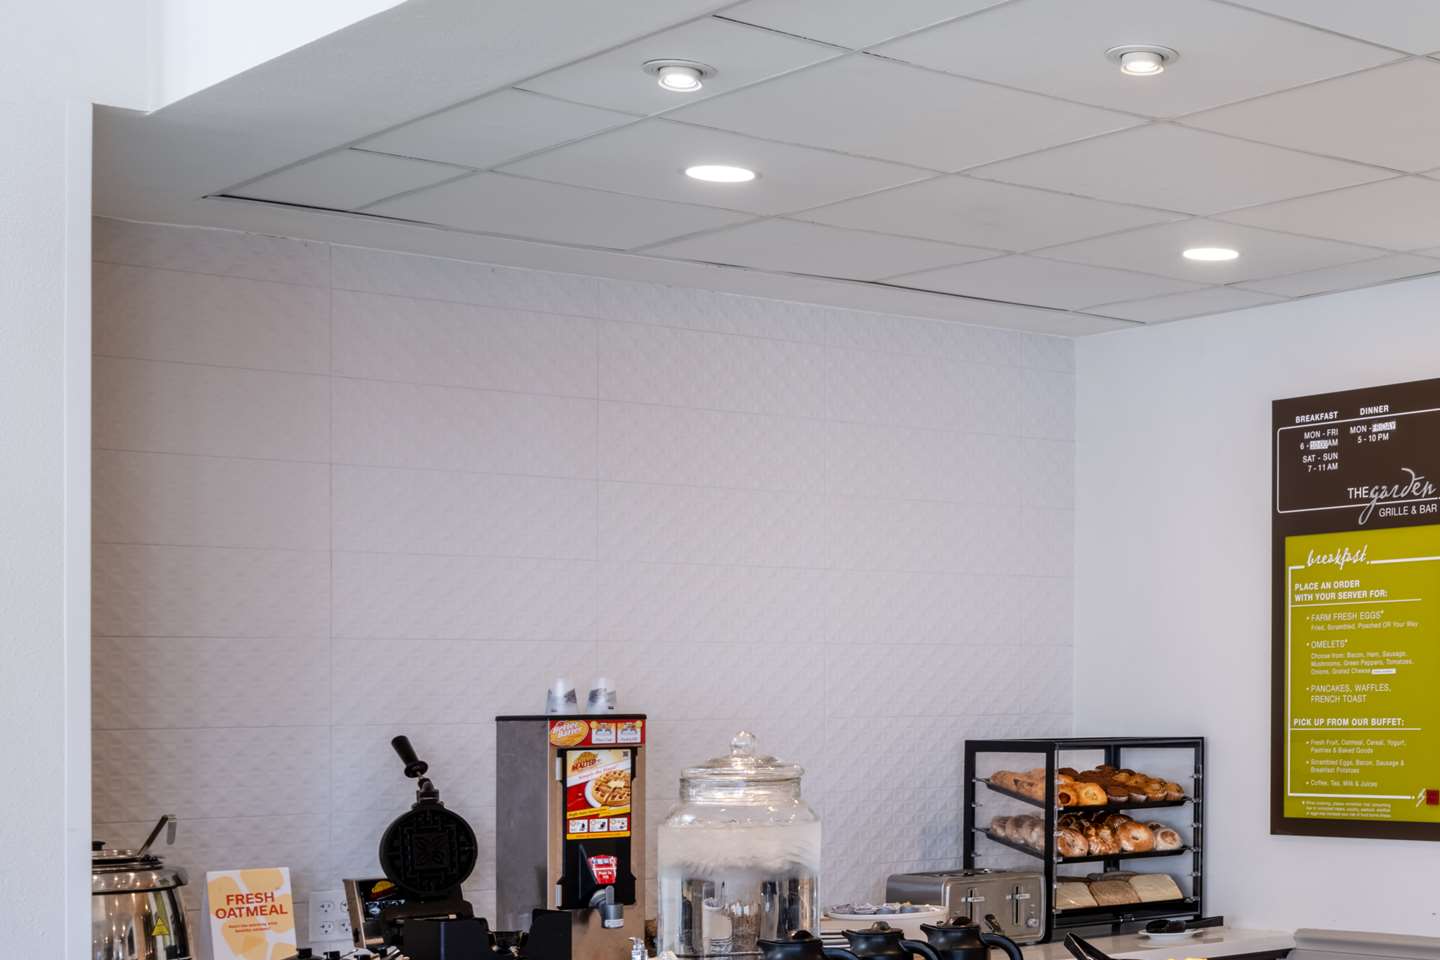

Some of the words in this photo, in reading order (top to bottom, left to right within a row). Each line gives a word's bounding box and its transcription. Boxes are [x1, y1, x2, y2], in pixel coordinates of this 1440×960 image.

[1359, 404, 1390, 416] DINNER
[1295, 411, 1338, 424] BREAKFAST
[1304, 430, 1321, 440] MON
[1326, 428, 1339, 437] FRI
[1349, 425, 1367, 434] MON
[1299, 442, 1305, 450] 6
[1327, 438, 1339, 447] AM
[1357, 435, 1362, 444] 5
[1368, 434, 1377, 442] 10
[1377, 432, 1389, 441] PM
[1302, 454, 1316, 464] SAT
[1322, 452, 1339, 461] SUN
[1307, 465, 1312, 473] 7
[1318, 464, 1326, 472] 11
[1326, 462, 1339, 471] AM
[1347, 486, 1370, 499] THE
[1358, 467, 1438, 525] garden
[1378, 505, 1409, 518] GRILLE
[1410, 504, 1417, 515] &
[1419, 503, 1438, 514] BAR
[1306, 544, 1369, 571] breakfast
[1294, 582, 1319, 592] PLACE
[1320, 582, 1332, 590] AN
[1333, 579, 1361, 589] ORDER
[1294, 593, 1313, 603] WITH
[1315, 592, 1337, 601] YOUR
[1338, 590, 1368, 600] SERVER
[1369, 589, 1388, 598] FOR:
[1311, 613, 1332, 622] FARM
[1333, 612, 1358, 621] FRESH
[1354, 683, 1392, 692] WAFFLES,
[1311, 695, 1341, 704] FRENCH
[1343, 694, 1367, 703] TOAST
[1293, 718, 1312, 727] PICK
[1314, 718, 1325, 726] UP
[1326, 718, 1349, 726] FROM
[1351, 718, 1369, 726] OUR
[1371, 717, 1405, 726] BUFFET:
[225, 892, 275, 906] FRESH
[215, 904, 288, 920] OATMEAL
